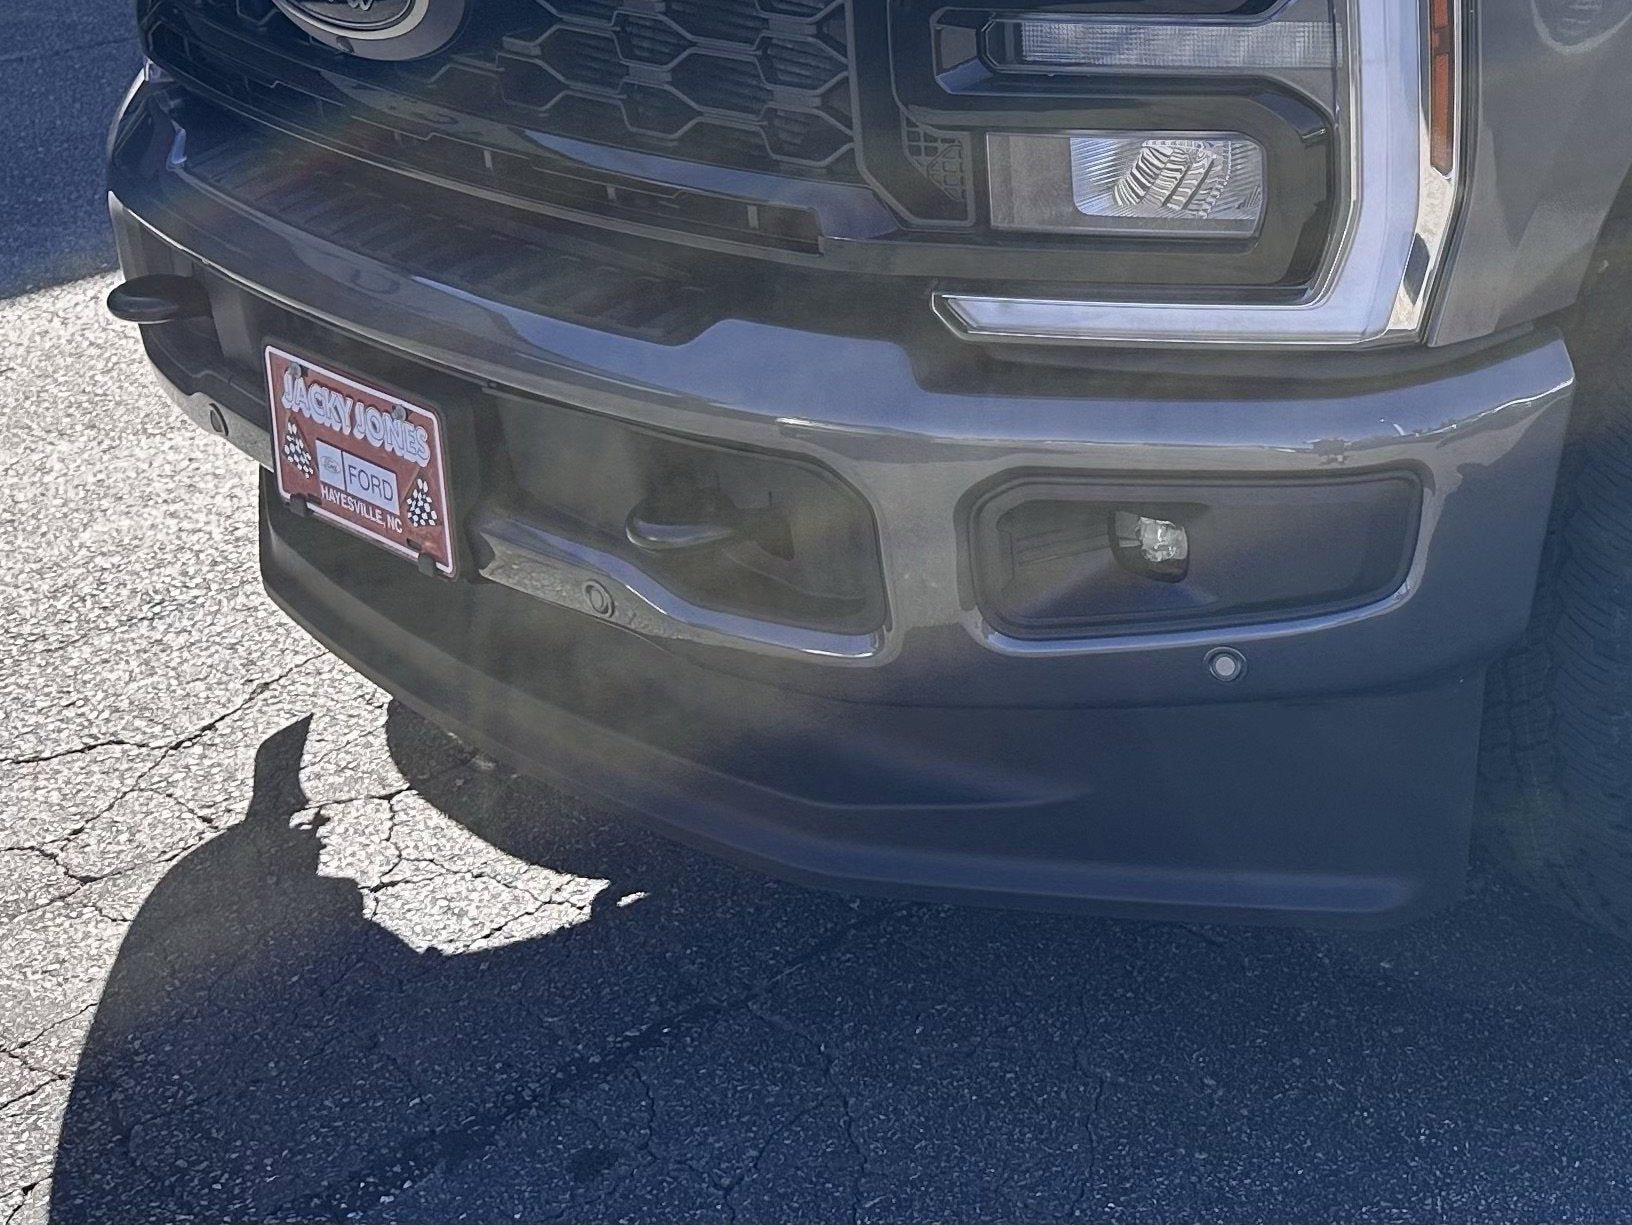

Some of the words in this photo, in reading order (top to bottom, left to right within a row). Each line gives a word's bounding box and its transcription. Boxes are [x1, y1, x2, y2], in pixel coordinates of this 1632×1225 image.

[281, 372, 353, 435] JACKY
[354, 403, 431, 468] JONES
[348, 464, 394, 502] FORD
[320, 484, 386, 529] HAYESVILLE,
[386, 514, 403, 534] NC
